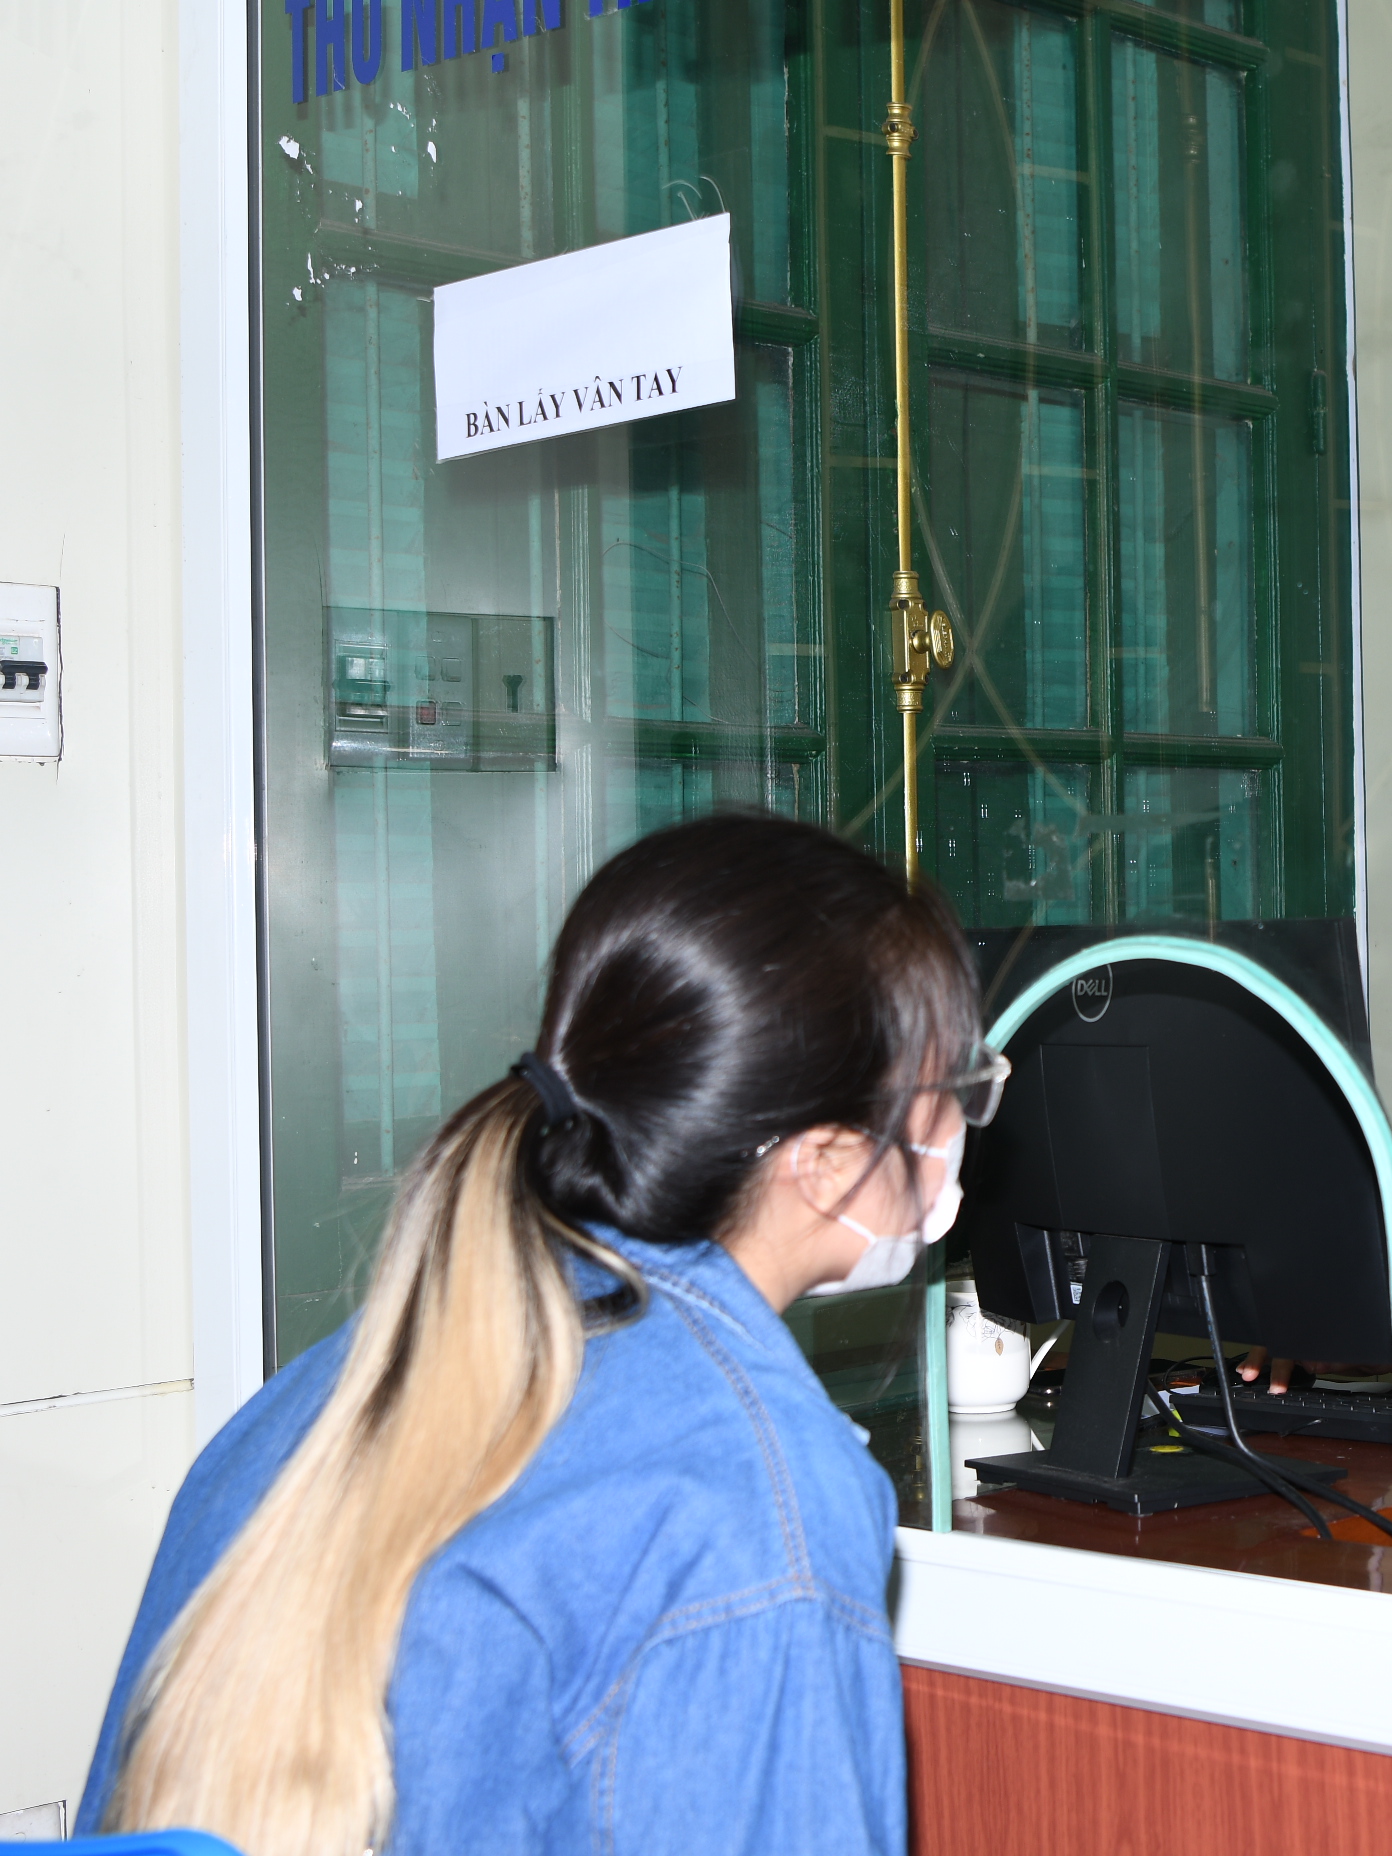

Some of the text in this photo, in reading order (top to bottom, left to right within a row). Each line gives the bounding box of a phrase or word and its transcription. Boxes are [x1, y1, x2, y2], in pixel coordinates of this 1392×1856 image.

[465, 366, 684, 438] BÀN LẤY VÂN TAY
[1077, 979, 1108, 996] DELL
